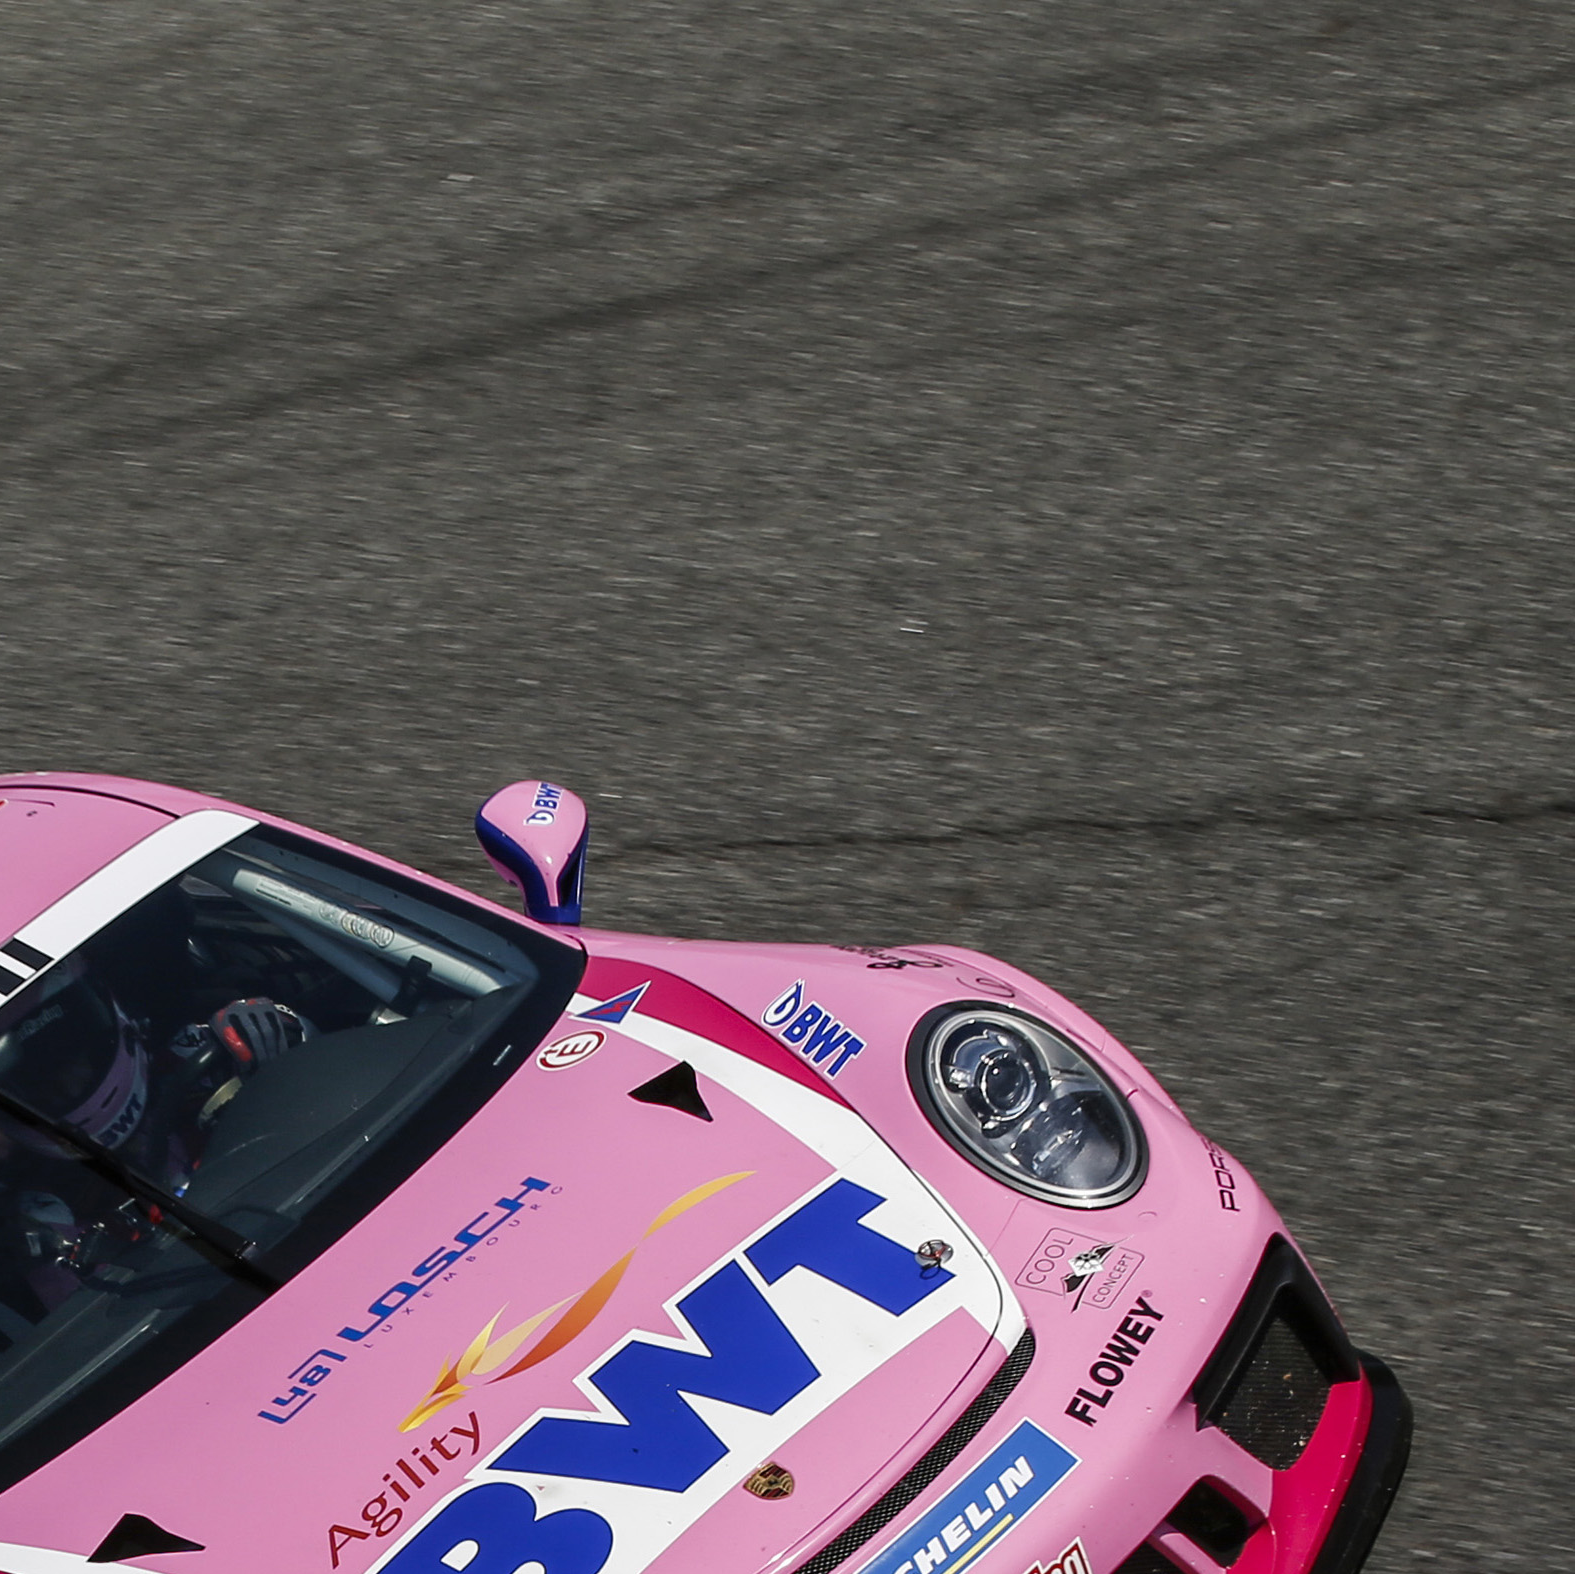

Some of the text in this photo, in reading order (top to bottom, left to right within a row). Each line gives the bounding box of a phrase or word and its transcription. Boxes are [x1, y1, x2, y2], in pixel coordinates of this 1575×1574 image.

[780, 1003, 865, 1078] BWT
[336, 1177, 551, 1341] LOSCH
[1026, 1237, 1074, 1285] COOL
[1092, 1253, 1134, 1303] CONCEPT
[328, 1411, 481, 1570] Agility
